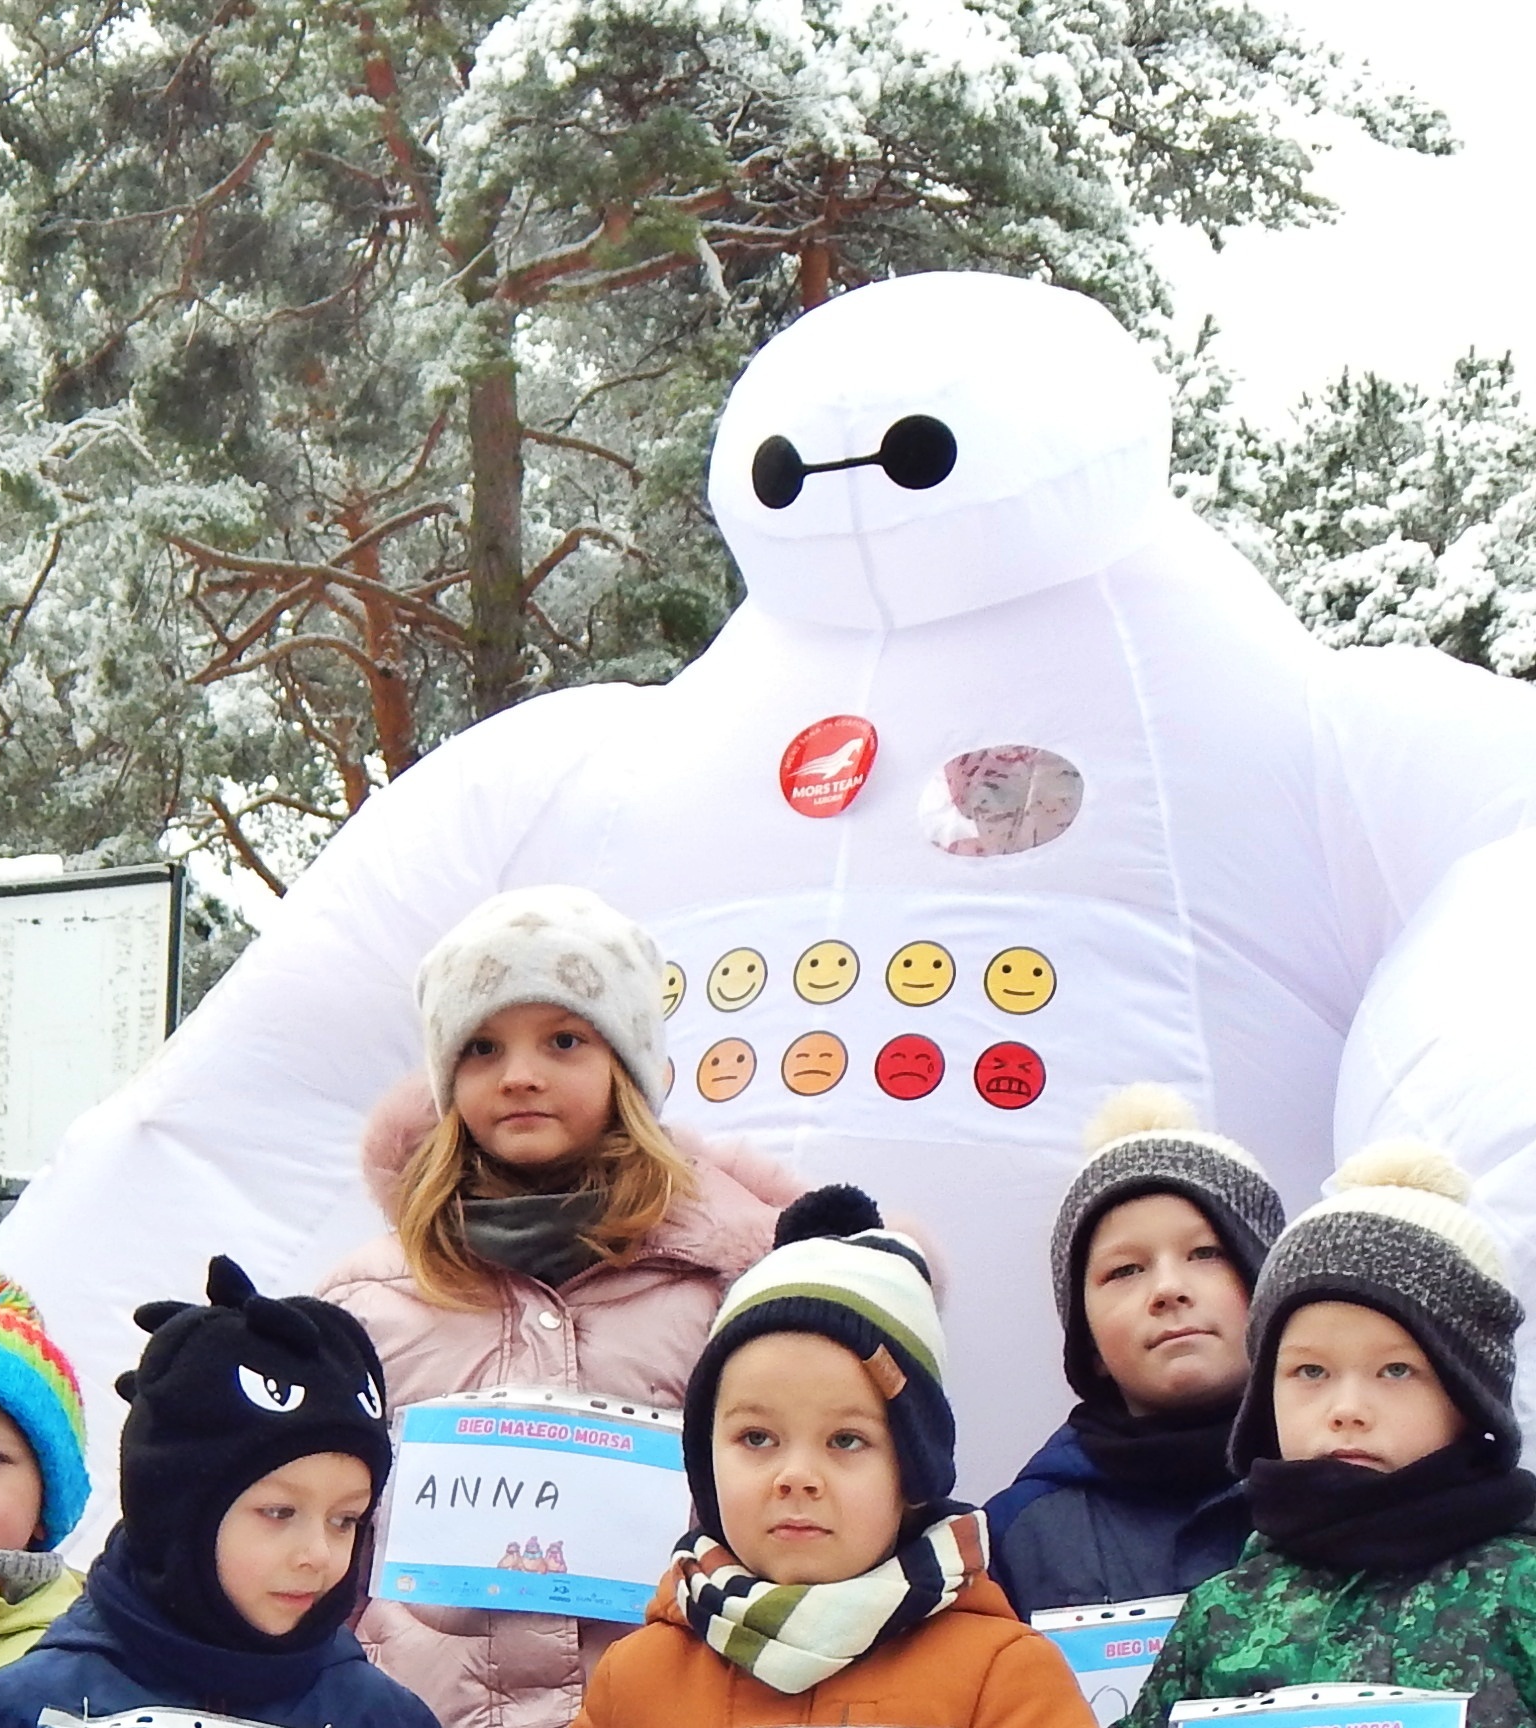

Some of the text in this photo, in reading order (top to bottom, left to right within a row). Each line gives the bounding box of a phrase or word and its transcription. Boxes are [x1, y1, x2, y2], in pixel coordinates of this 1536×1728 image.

[792, 774, 864, 799] MORS TEAM
[456, 1416, 635, 1453] BIEG MAŁEGO MORSA
[415, 1474, 561, 1510] ANNA
[1104, 1639, 1144, 1659] BIEG
